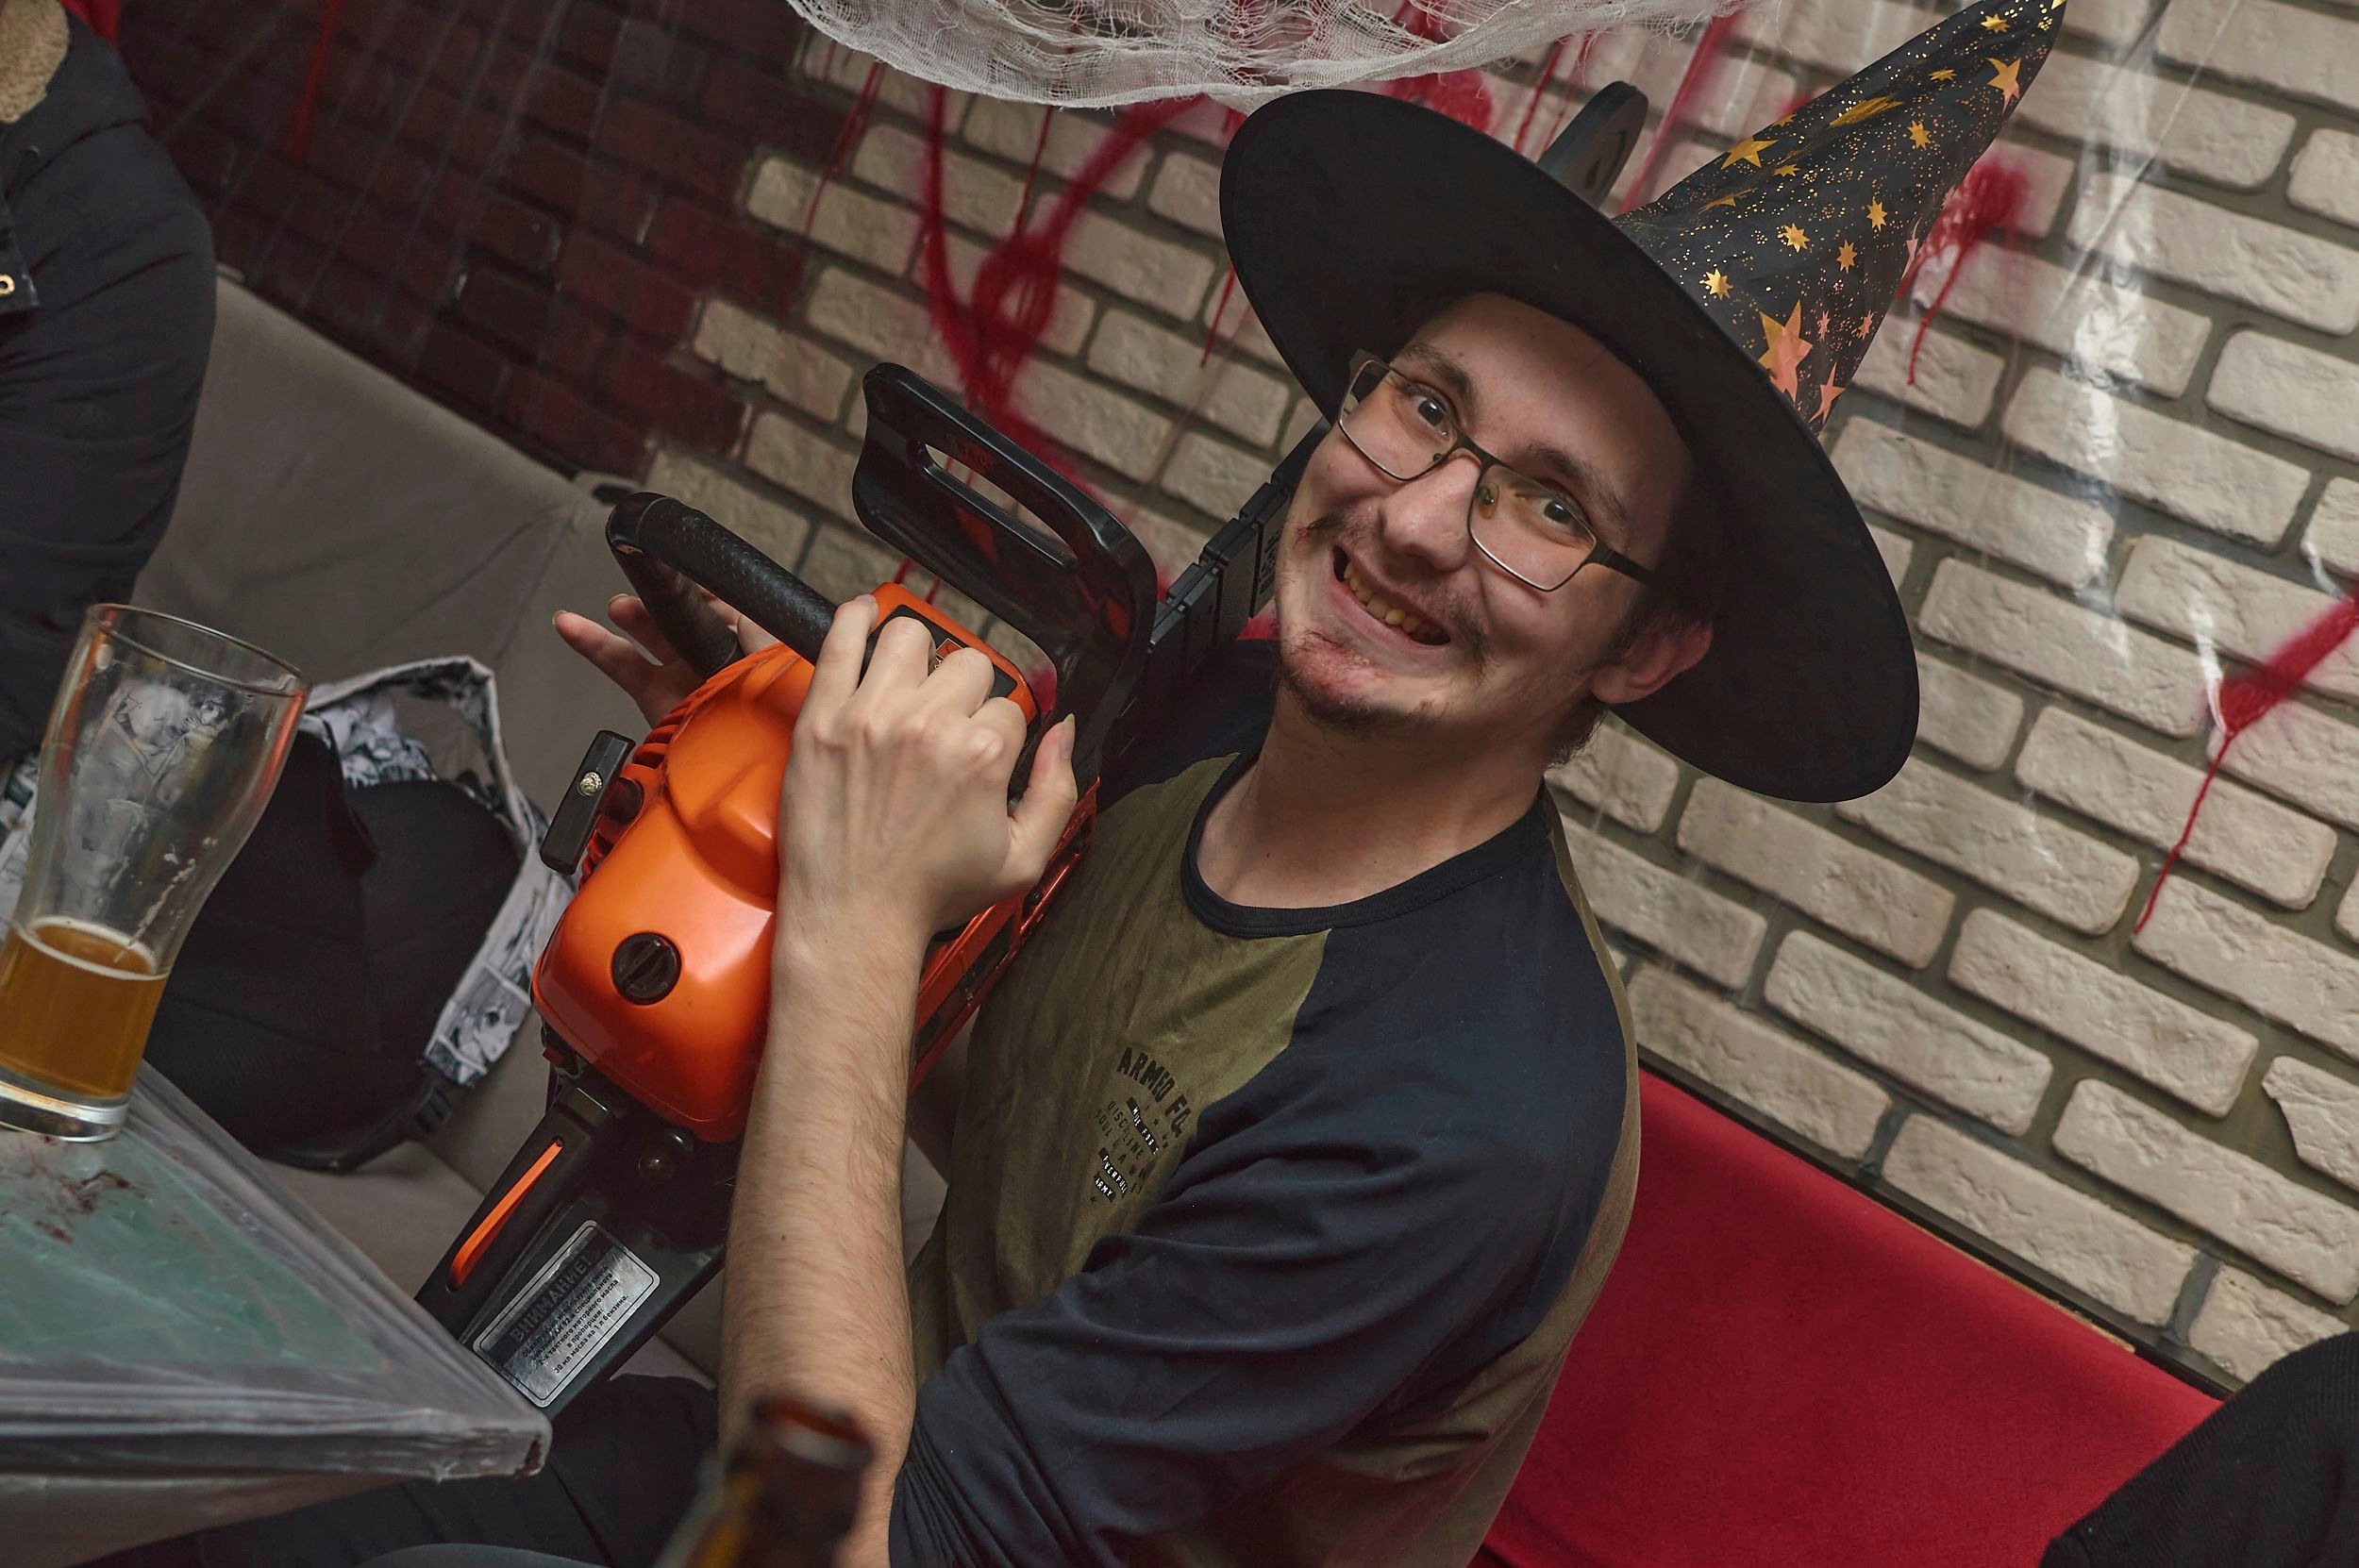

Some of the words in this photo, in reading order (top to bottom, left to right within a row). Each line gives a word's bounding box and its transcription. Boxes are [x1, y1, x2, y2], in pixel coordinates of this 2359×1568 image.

[1117, 1047, 1175, 1102] ARMED
[1164, 1094, 1191, 1138] FO
[1095, 1177, 1113, 1197] ARMY
[509, 1255, 592, 1343] ВНИМАНИЕ!
[547, 1327, 573, 1355] тактного
[572, 1297, 602, 1328] моторного
[600, 1278, 618, 1298] масла
[553, 1363, 562, 1373] 30
[561, 1356, 571, 1365] мл
[570, 1337, 588, 1356] масла
[587, 1329, 595, 1338] на
[601, 1293, 628, 1321] бензина.
[561, 1317, 571, 1326] 92
[574, 1273, 612, 1313] специального
